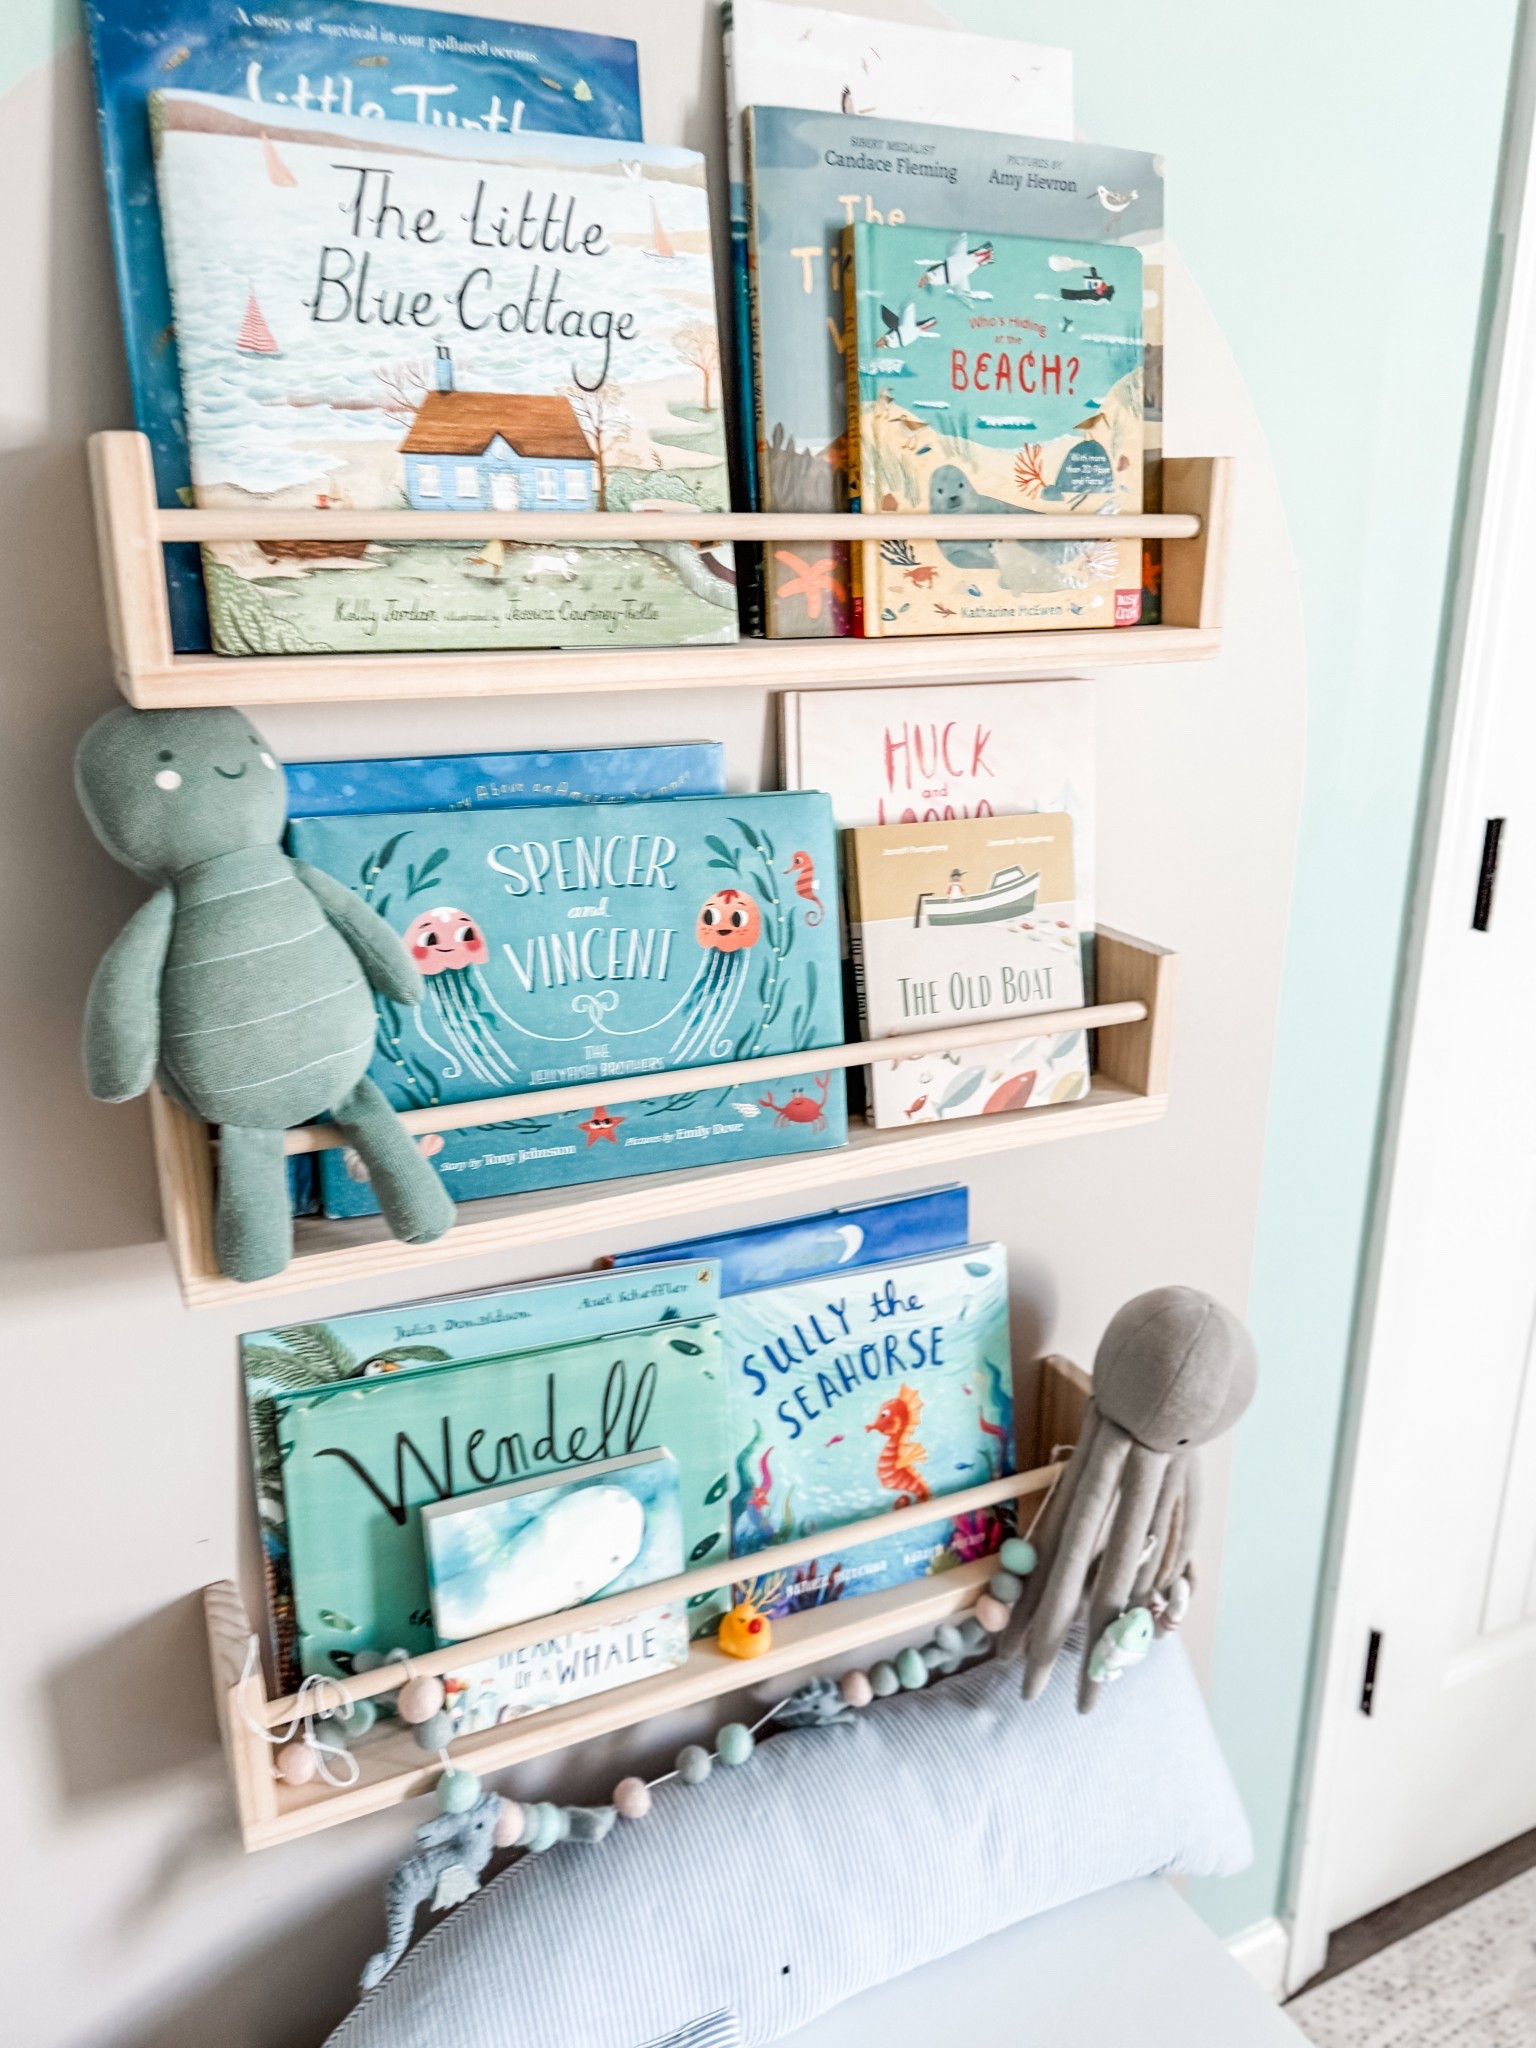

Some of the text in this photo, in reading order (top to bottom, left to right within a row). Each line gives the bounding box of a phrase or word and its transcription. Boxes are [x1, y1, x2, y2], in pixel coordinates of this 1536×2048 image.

[295, 16, 313, 33] of
[318, 24, 378, 42] survival
[824, 149, 959, 184] Candace Fleming
[988, 168, 1078, 192] Amy Hevron
[1051, 160, 1064, 170] BY
[331, 163, 611, 256] The Little
[301, 246, 641, 392] Blue Cottage
[952, 349, 1079, 395] BEACH?
[961, 606, 1015, 618] Katharine
[884, 721, 995, 793] HUCK
[922, 783, 949, 799] and
[487, 835, 678, 896] SPENCER
[567, 896, 612, 918] and
[503, 927, 678, 992] VINCENT
[896, 966, 1053, 1017] THE OLD BOAT
[584, 1044, 611, 1060] THE
[600, 1057, 665, 1077] BROTHERS
[675, 1126, 711, 1140] Emily
[482, 1153, 517, 1166] Tony
[443, 1310, 532, 1332] Donaldson
[742, 1280, 925, 1397] SULLY the
[777, 1326, 944, 1440] SEAHORSE
[313, 1360, 658, 1526] Wendell
[557, 1627, 656, 1685] WHALE
